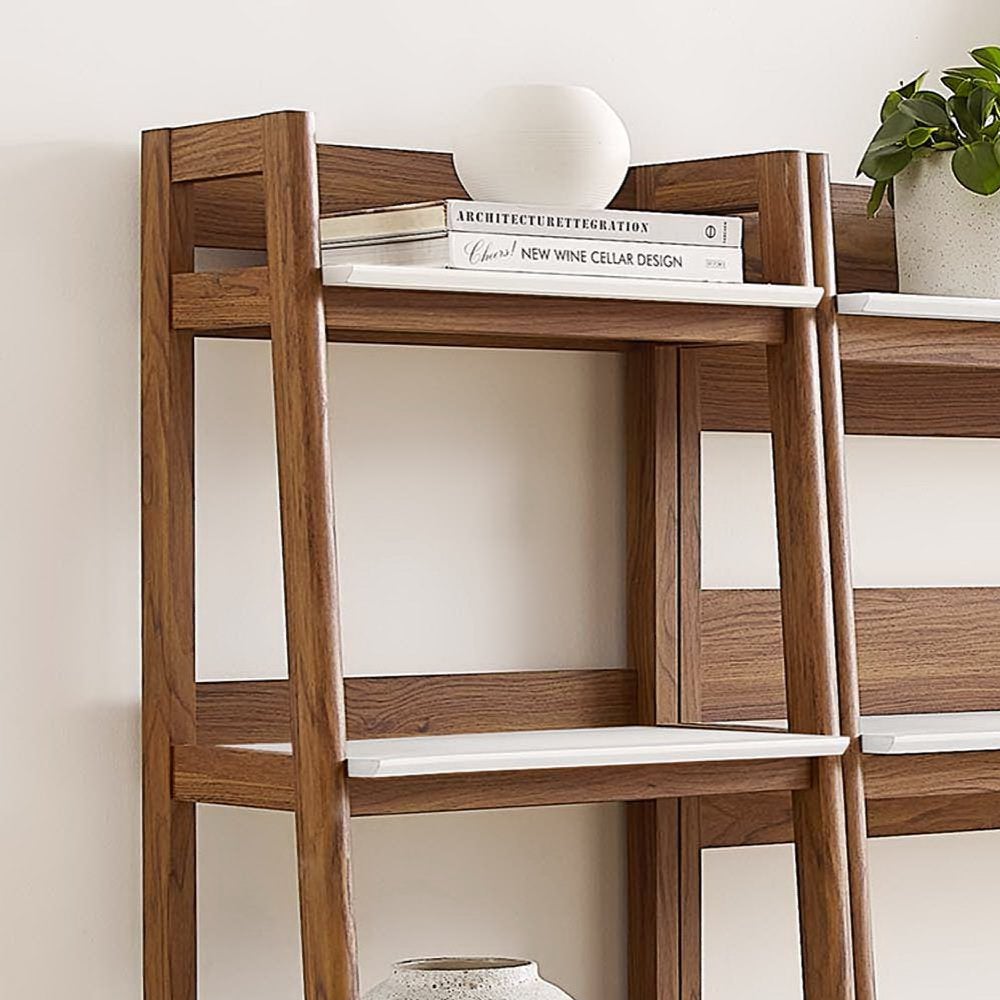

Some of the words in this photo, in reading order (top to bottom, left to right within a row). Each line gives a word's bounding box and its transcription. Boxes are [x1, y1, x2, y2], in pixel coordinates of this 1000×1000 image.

[456, 210, 650, 233] ARCHITECTURETTEGRATION
[521, 247, 551, 261] NEW
[553, 249, 587, 263] WINE
[590, 250, 634, 265] CELLAR
[637, 252, 684, 268] DESIGN
